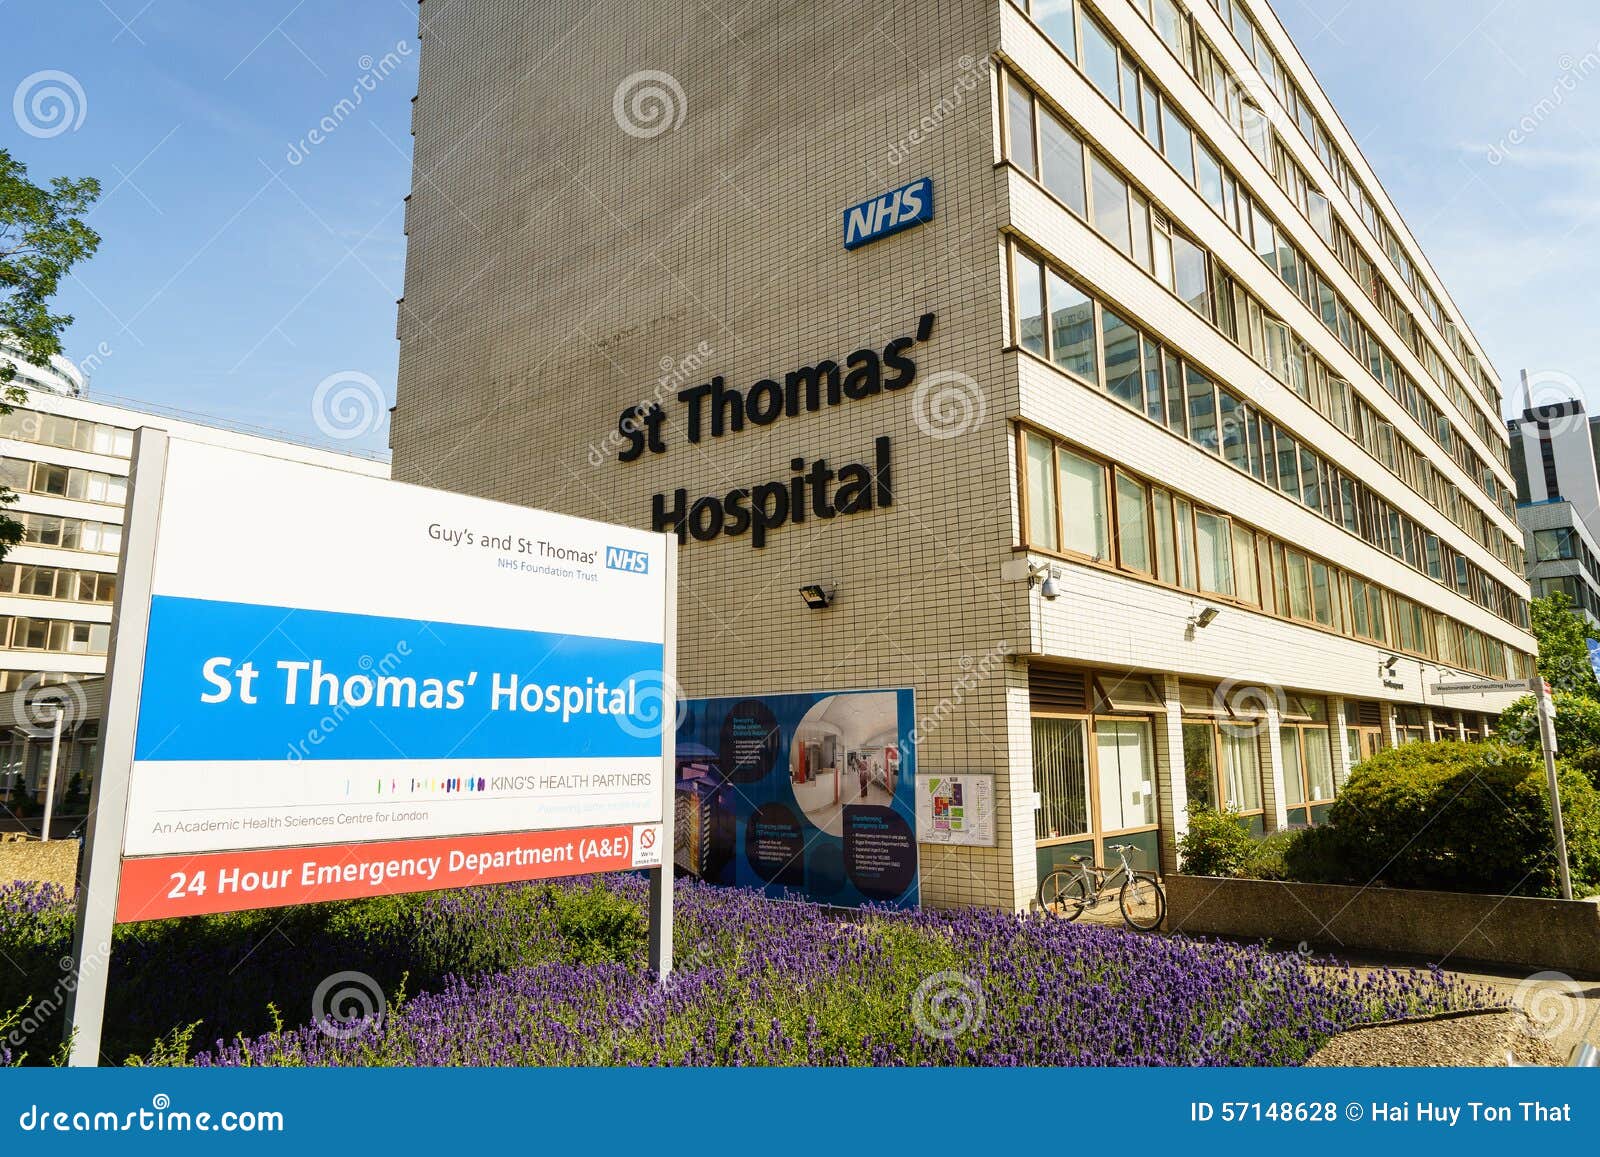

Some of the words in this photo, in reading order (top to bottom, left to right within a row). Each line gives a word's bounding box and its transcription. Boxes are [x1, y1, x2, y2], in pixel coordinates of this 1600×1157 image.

[845, 181, 924, 244] NHS
[618, 403, 666, 462] St
[678, 312, 935, 444] Thomas'
[652, 436, 892, 548] Hospital
[428, 523, 474, 547] Guy's
[480, 535, 512, 551] and
[518, 537, 533, 555] St
[537, 541, 598, 565] Thomas'
[497, 557, 518, 570] NHS
[520, 561, 574, 579] Foundation
[576, 569, 598, 582] Trust
[607, 547, 648, 572] NHS
[200, 656, 259, 705] St
[276, 659, 478, 710] Thomas'
[491, 672, 636, 723] Hospital
[490, 775, 536, 791] KING'S
[539, 774, 589, 790] HEALTH
[592, 773, 652, 788] PARTNERS
[152, 822, 172, 835] An
[174, 818, 240, 833] Academic
[242, 815, 282, 830] Health
[283, 814, 335, 828] Sciences
[336, 812, 373, 825] Centre
[374, 811, 391, 823] for
[391, 810, 429, 823] London
[168, 870, 207, 899] 24
[217, 867, 292, 894] Hour
[301, 856, 441, 886] Emergency
[448, 842, 574, 875] Department
[579, 835, 630, 863] (A&E)
